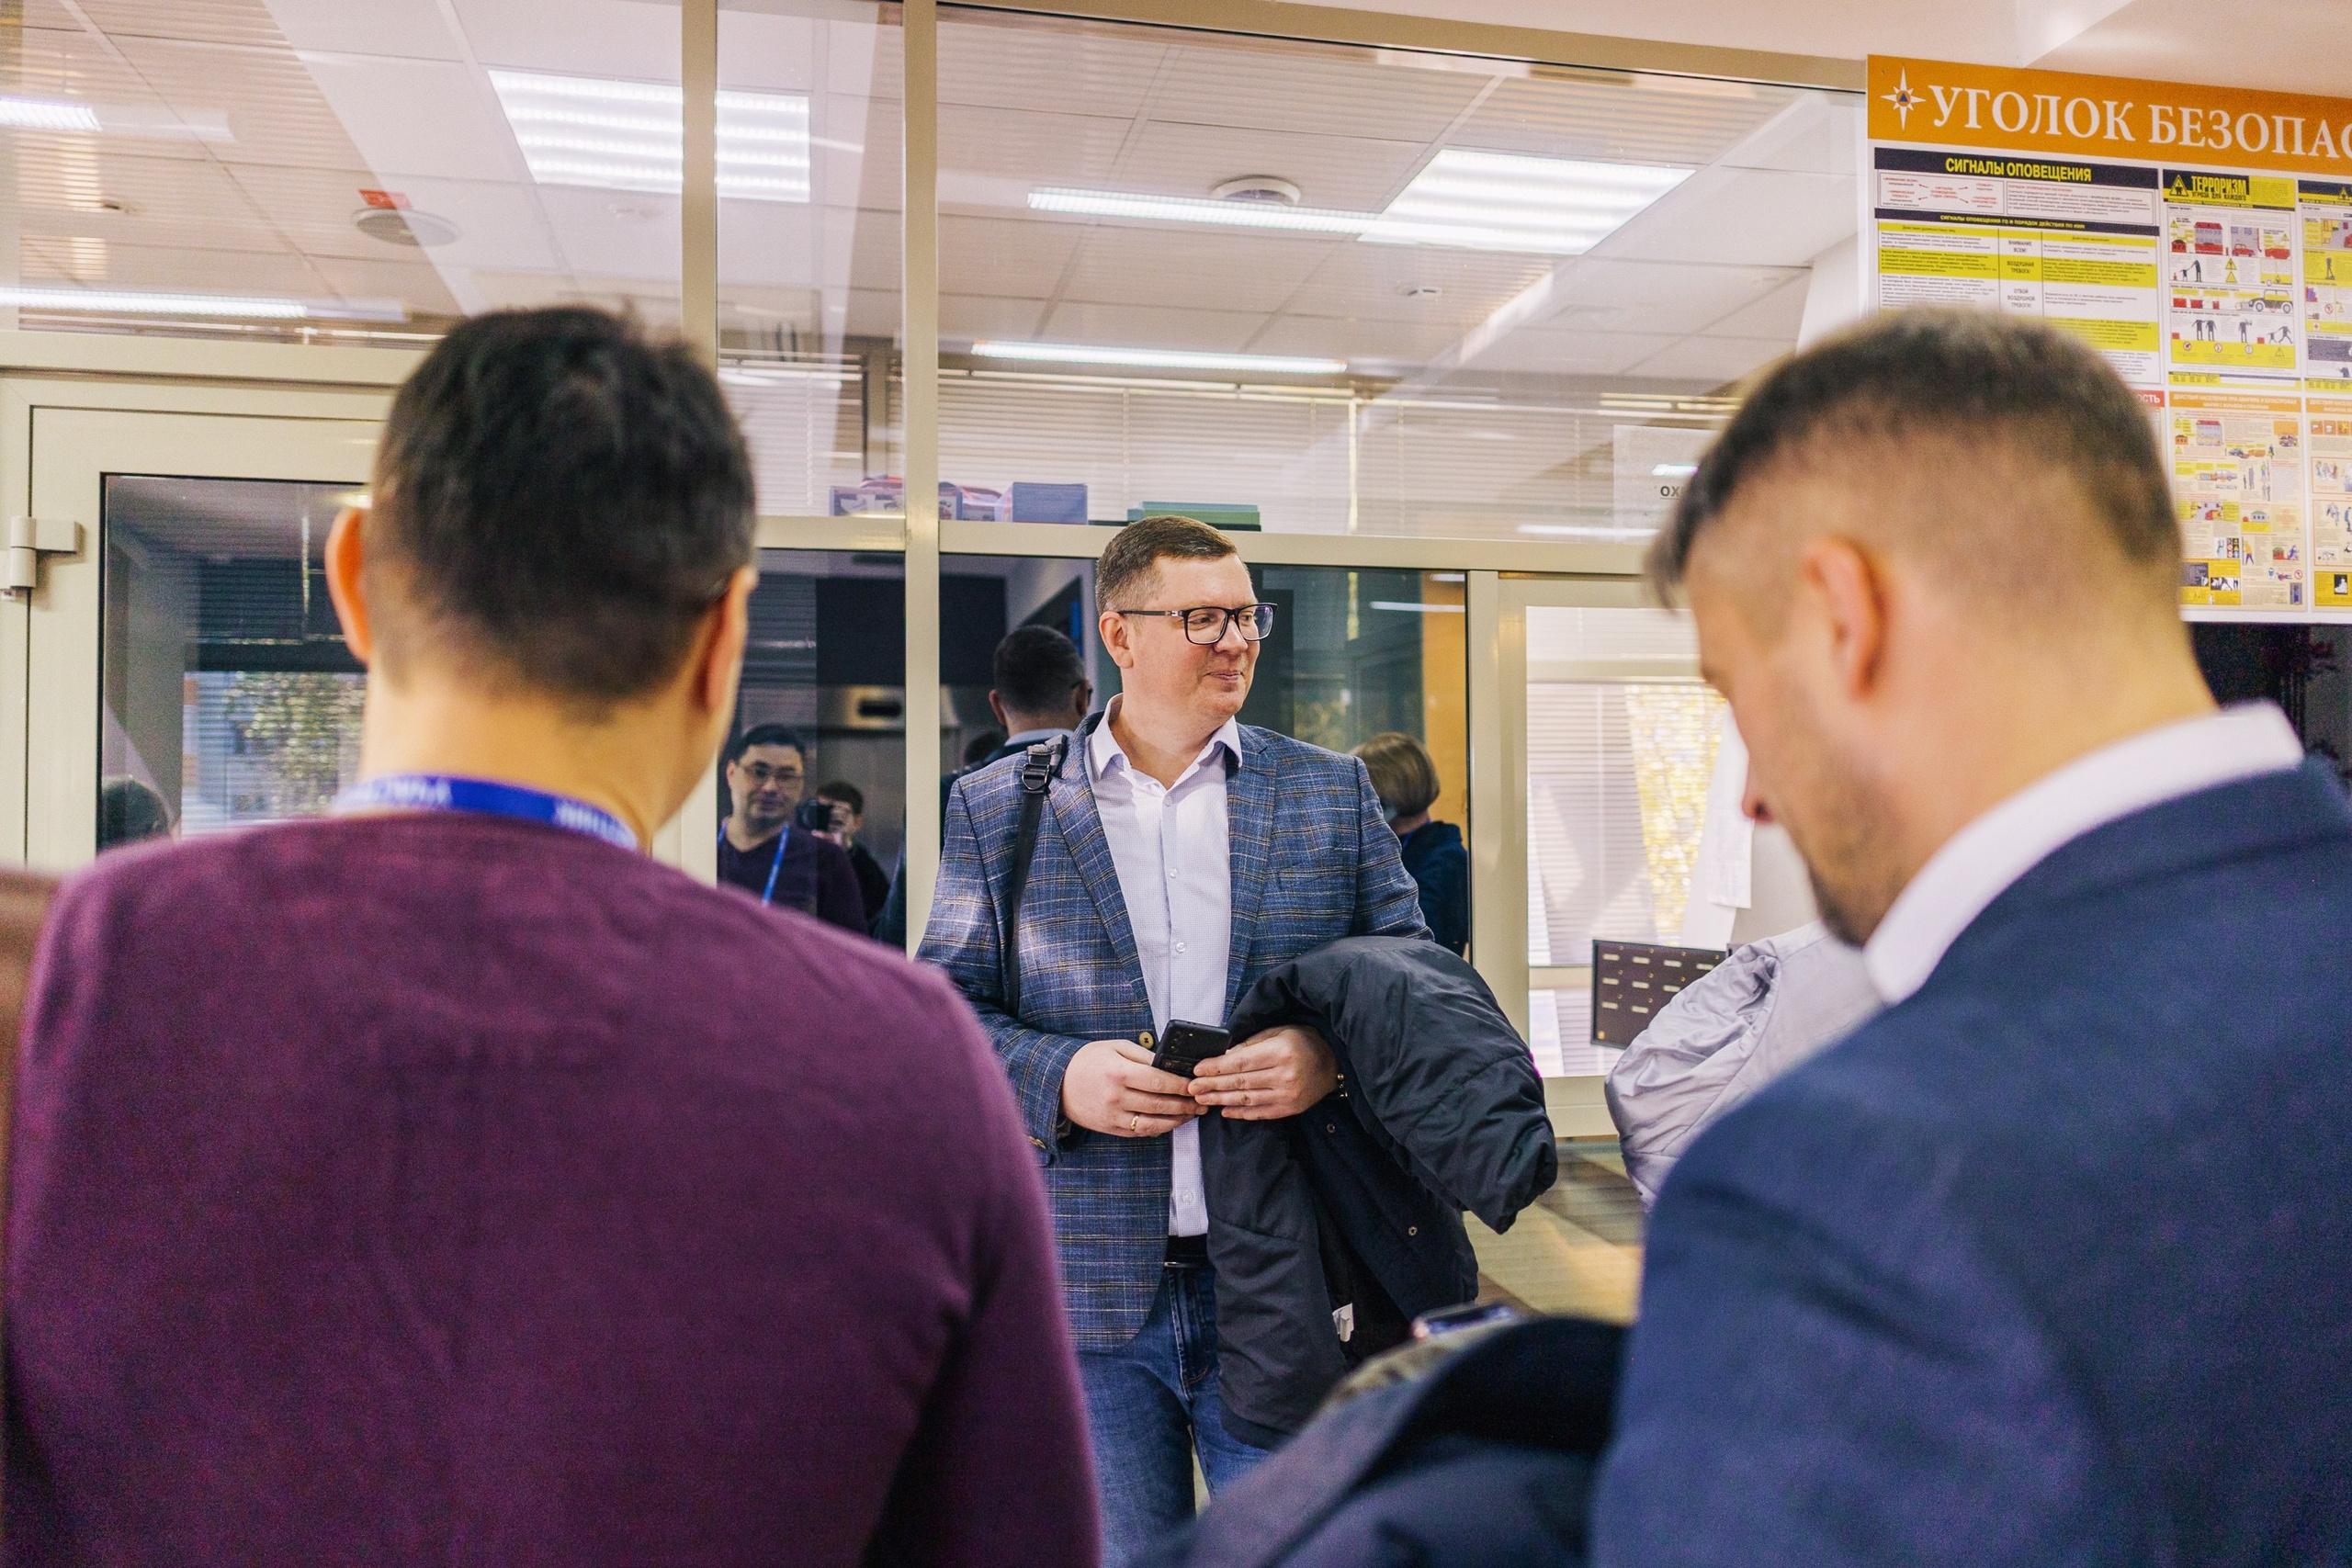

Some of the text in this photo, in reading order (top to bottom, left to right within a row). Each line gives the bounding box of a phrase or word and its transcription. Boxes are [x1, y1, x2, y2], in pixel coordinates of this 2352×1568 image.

[1928, 85, 2136, 141] УГОЛОК
[1945, 157, 2092, 182] СИГНАЛЫ ОПОВЕЩЕНИЯ
[2191, 175, 2246, 196] ТЕРРОРИЗМ
[1660, 486, 1680, 497] ОХ
